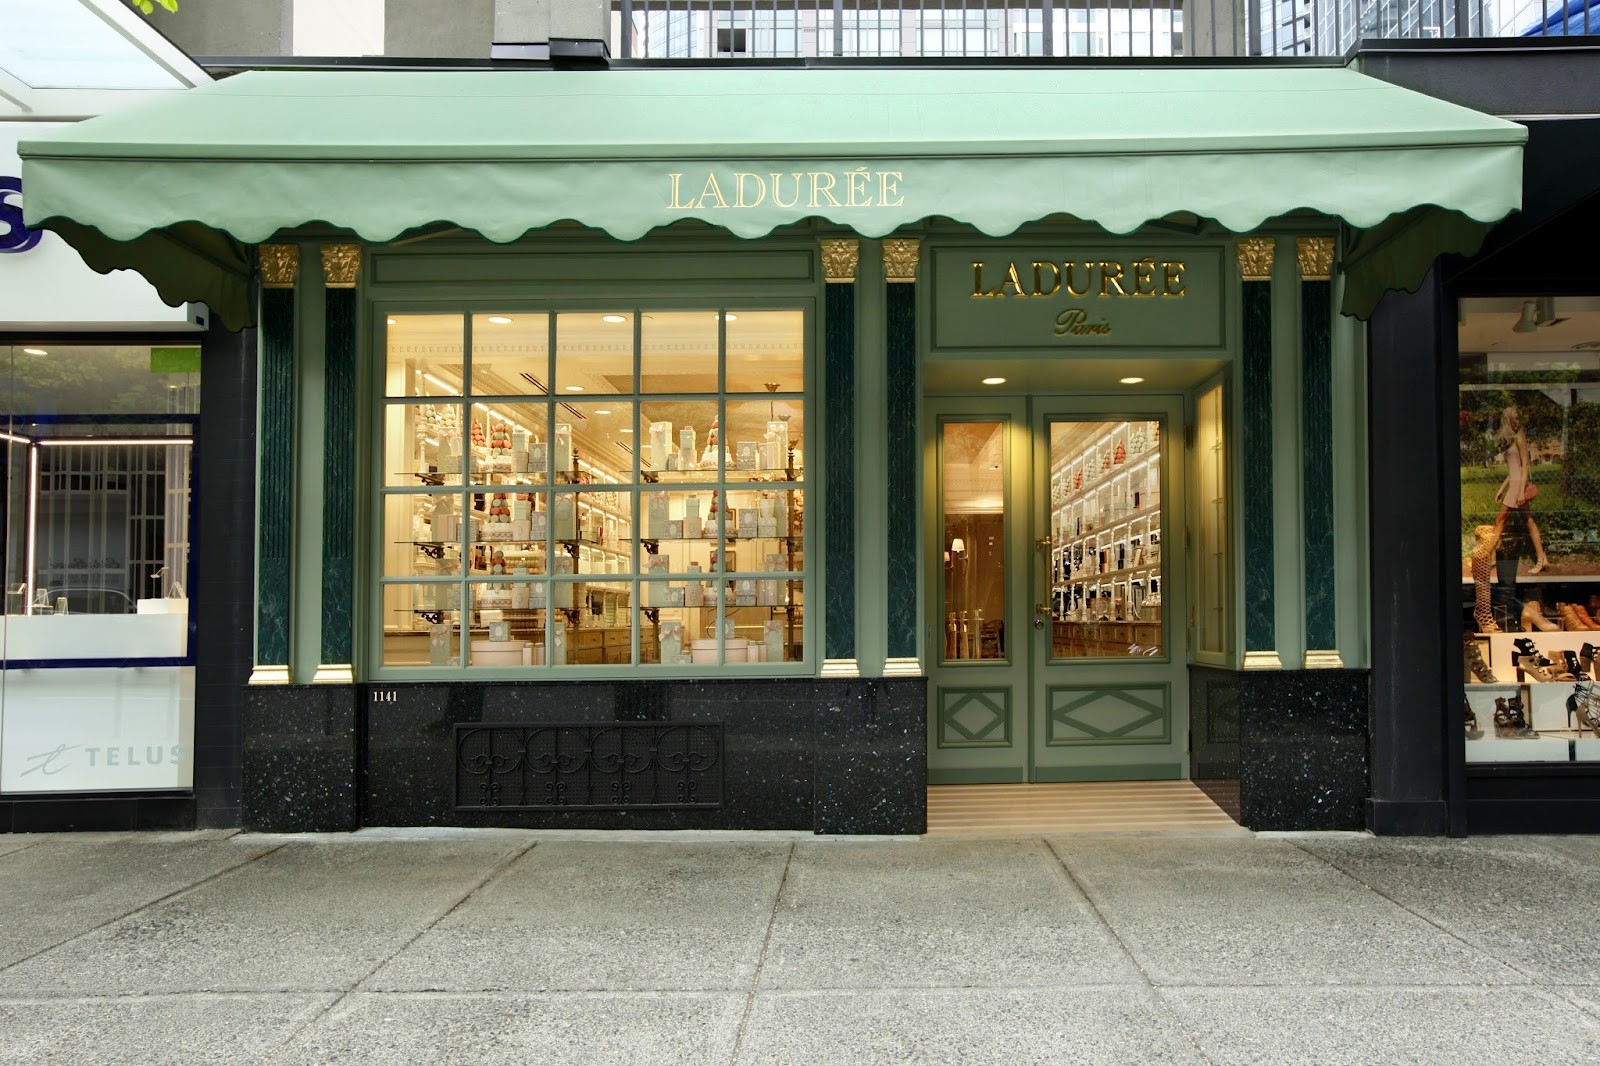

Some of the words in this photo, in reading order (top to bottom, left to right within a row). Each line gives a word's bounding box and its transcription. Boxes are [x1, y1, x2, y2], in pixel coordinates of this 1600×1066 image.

[666, 167, 905, 209] LADURÉE
[969, 257, 1188, 298] LADURÉE
[1054, 307, 1112, 336] Paris
[373, 690, 397, 702] 1141
[85, 745, 185, 767] TELUS
